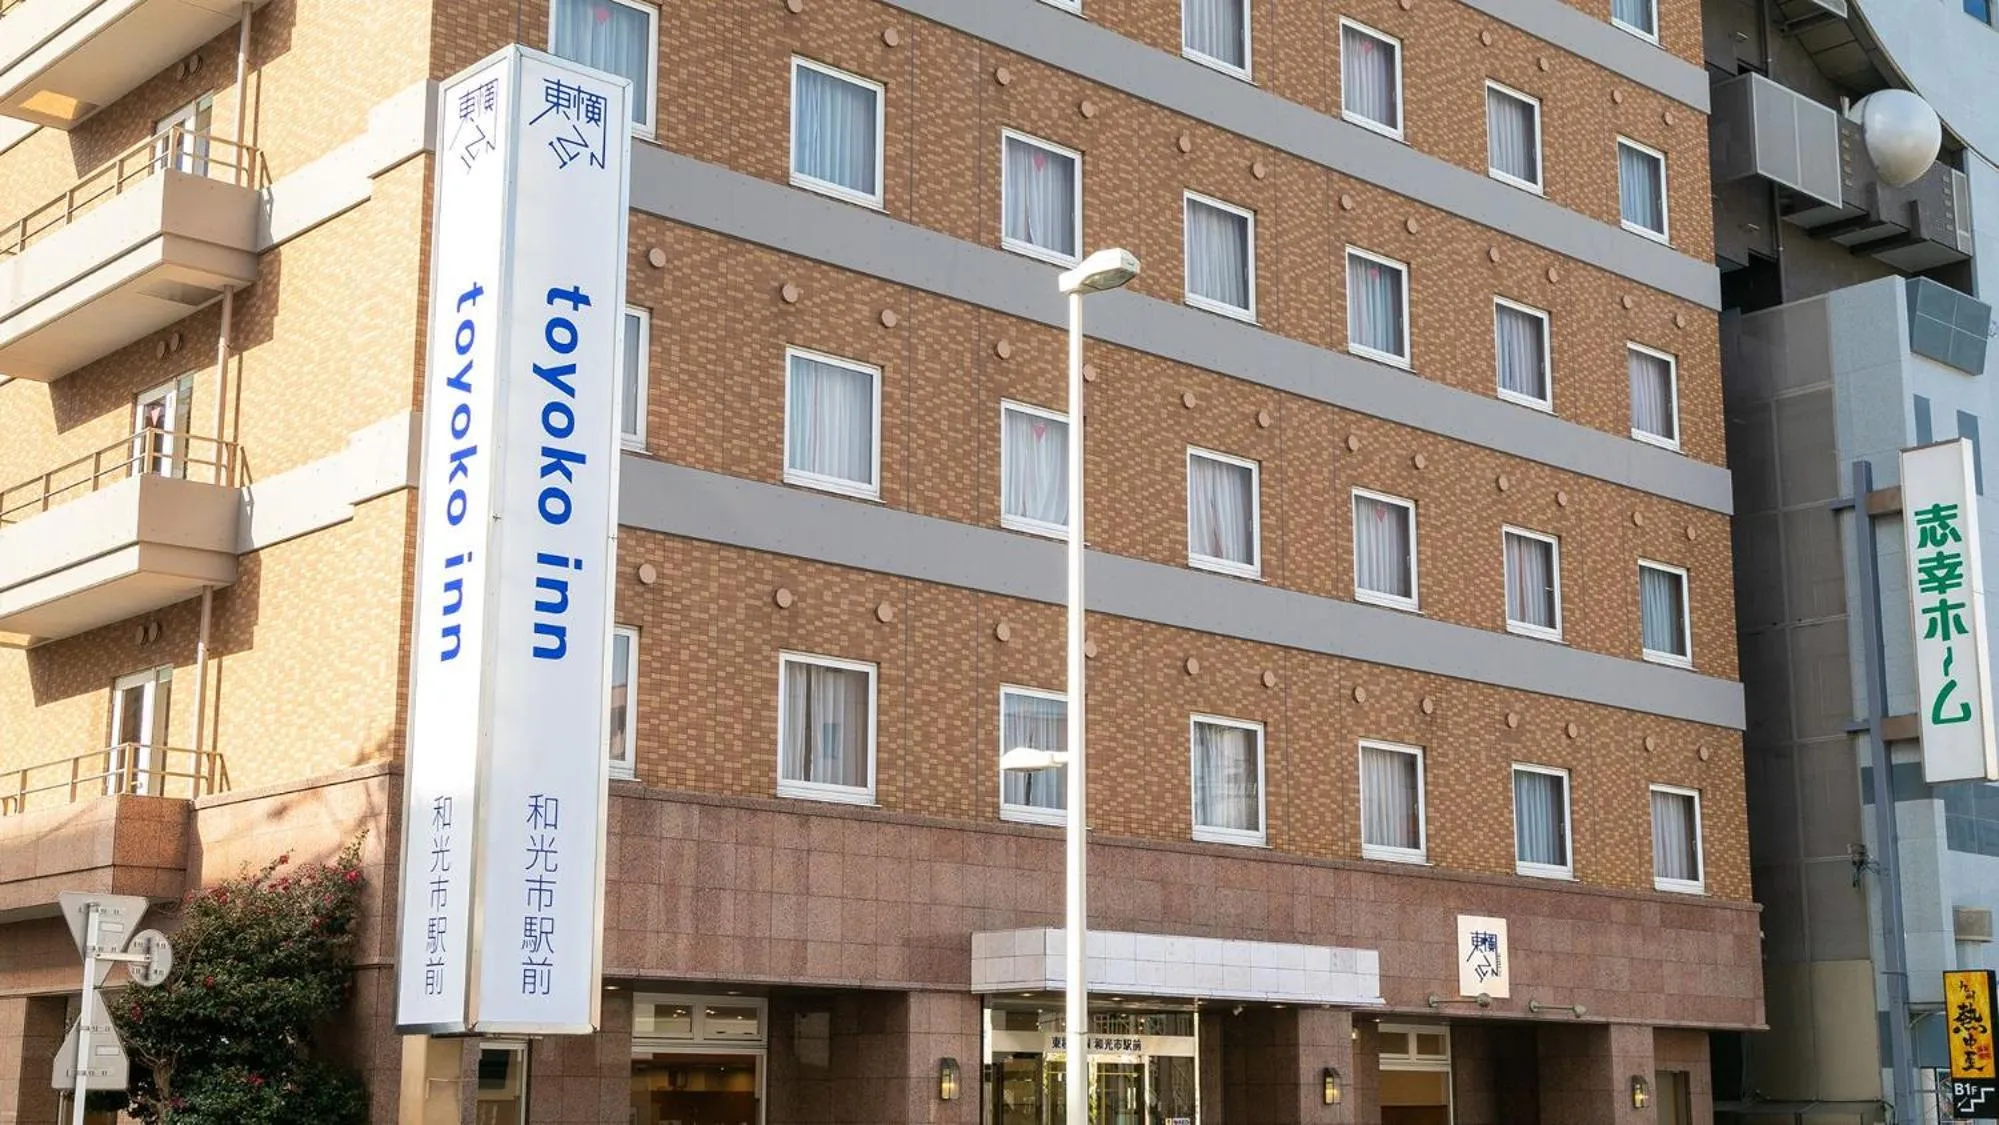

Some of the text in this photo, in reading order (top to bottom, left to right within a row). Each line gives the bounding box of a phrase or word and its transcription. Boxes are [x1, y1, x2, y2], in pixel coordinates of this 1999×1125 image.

[440, 280, 485, 662] toyoko inn
[532, 284, 592, 660] toyoko inn
[1914, 502, 1971, 726] 志幸ホーム
[425, 795, 453, 995] 和光市駅前
[522, 793, 559, 996] 和光市駅前
[1954, 1083, 1978, 1096] B1F
